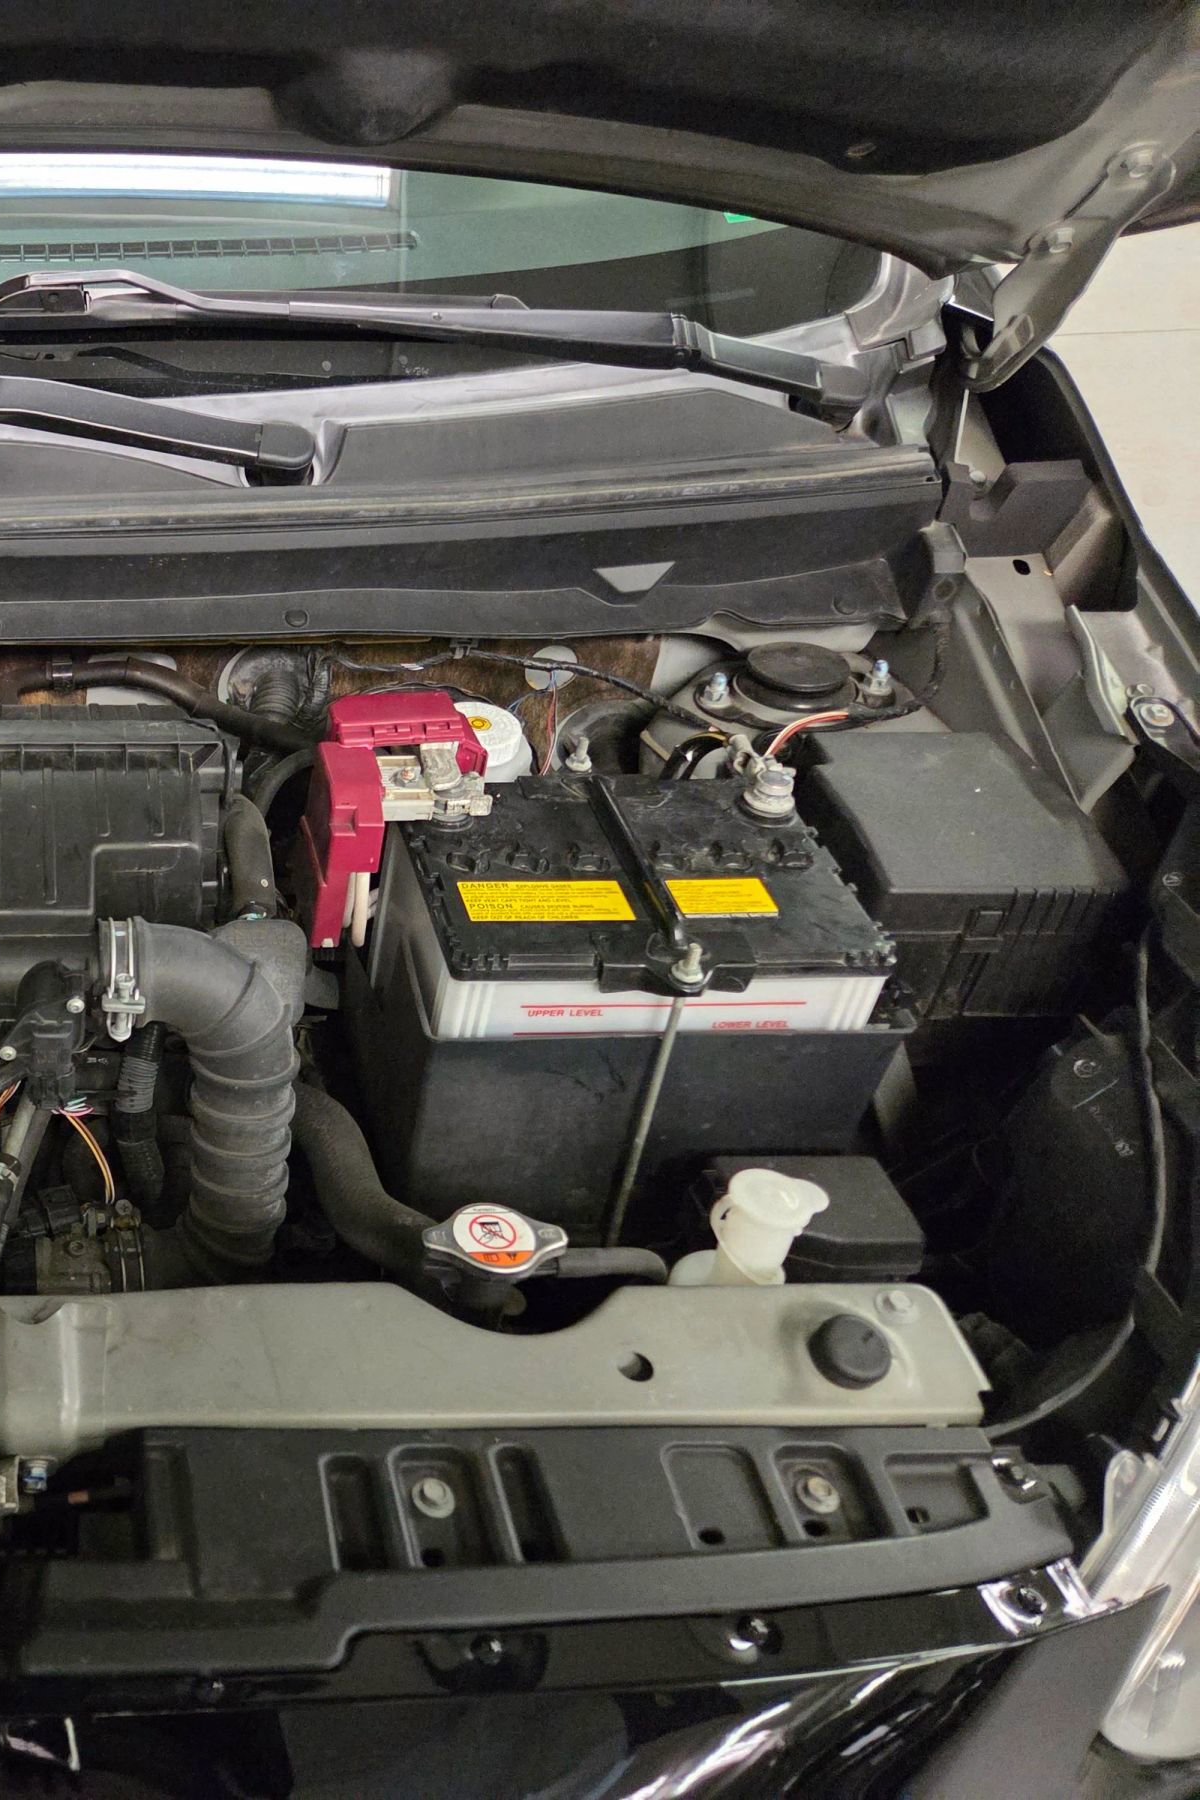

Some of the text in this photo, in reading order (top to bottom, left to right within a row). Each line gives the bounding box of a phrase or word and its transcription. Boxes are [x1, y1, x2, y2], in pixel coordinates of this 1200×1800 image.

[527, 1008, 603, 1017] UPPER LEVEL
[712, 1020, 789, 1029] LOWER LEVEL
